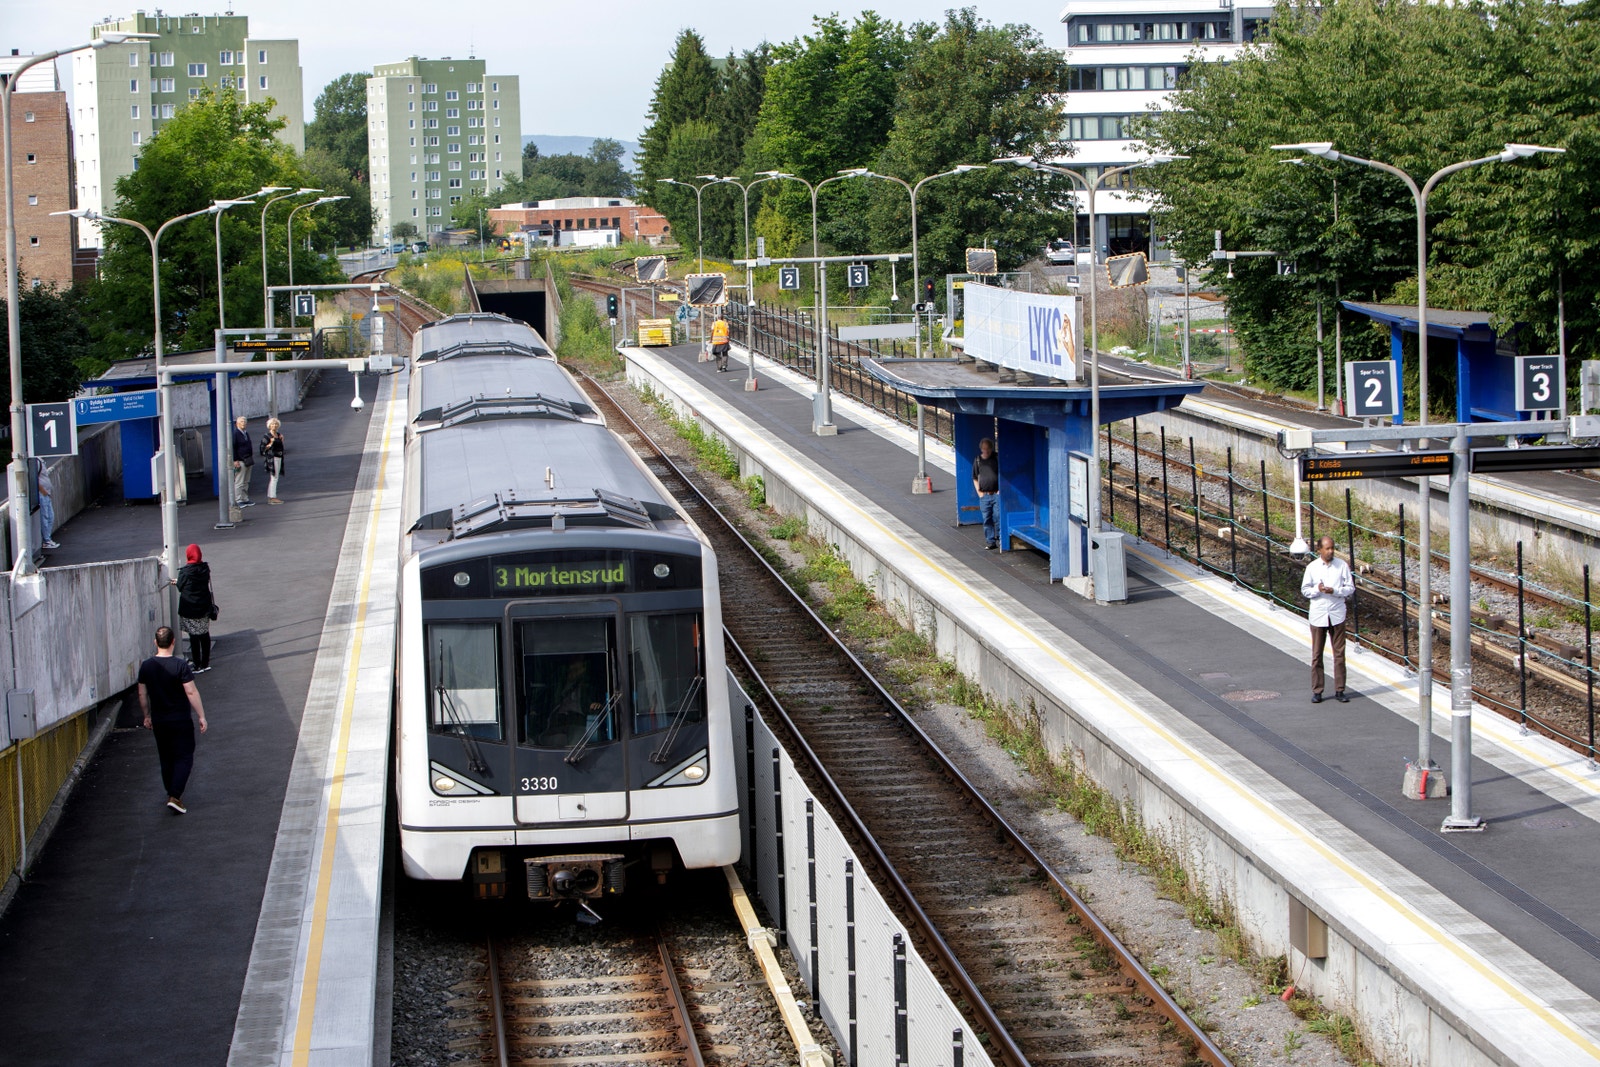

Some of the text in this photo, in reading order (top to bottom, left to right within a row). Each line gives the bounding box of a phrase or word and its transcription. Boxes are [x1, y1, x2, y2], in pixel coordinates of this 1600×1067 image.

[785, 274, 793, 286] 2
[854, 271, 862, 283] 3
[302, 300, 308, 313] 1
[1364, 378, 1383, 408] 2
[1532, 372, 1551, 402] 3
[44, 419, 58, 448] 1
[1309, 460, 1315, 469] 3
[496, 563, 624, 587] 3 Mortensrud
[521, 776, 558, 791] 3330
